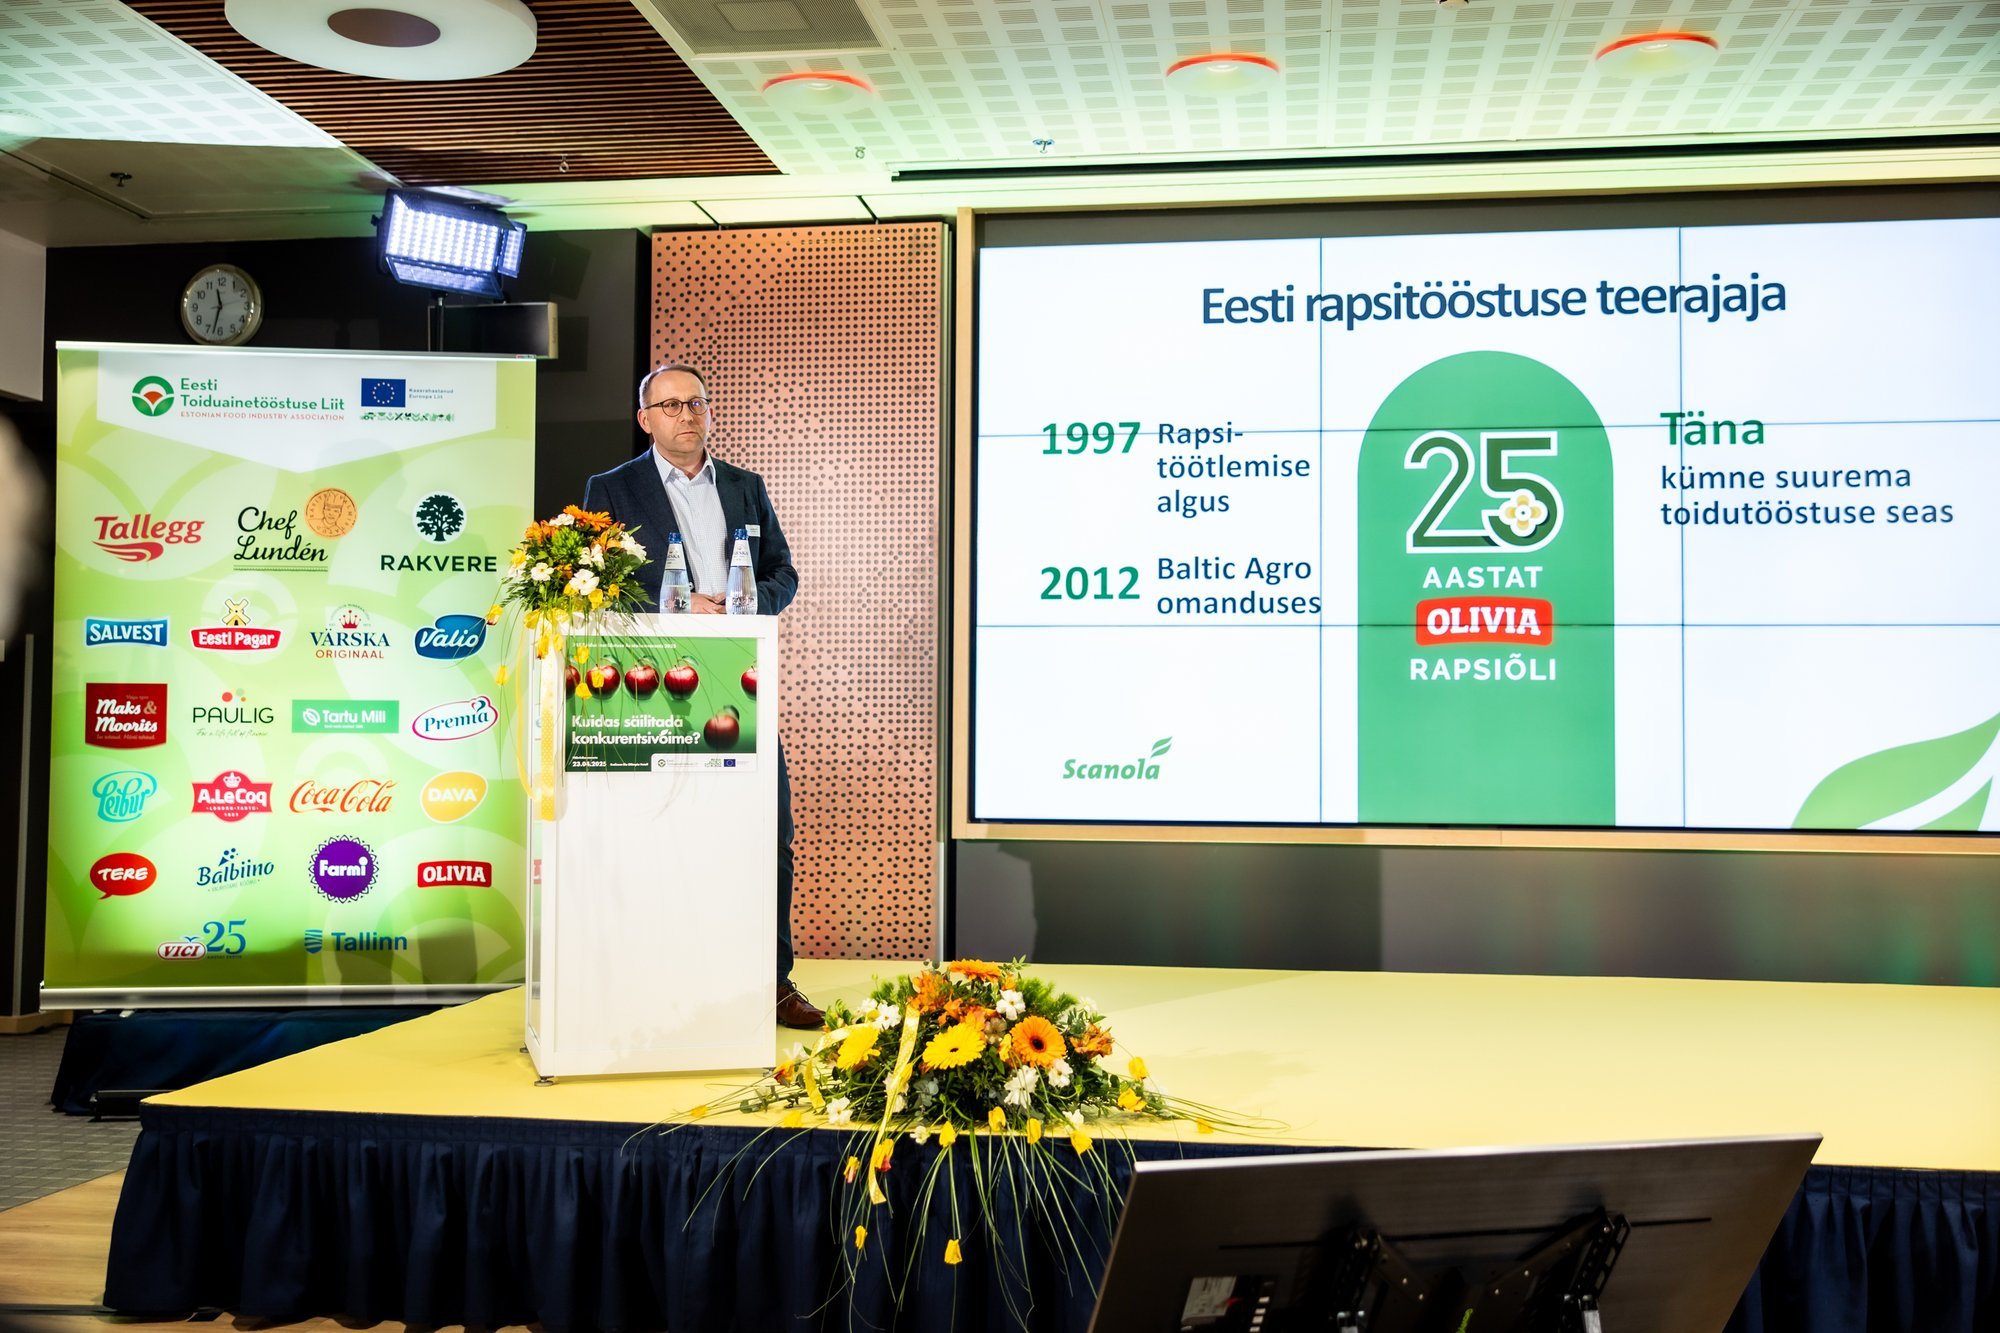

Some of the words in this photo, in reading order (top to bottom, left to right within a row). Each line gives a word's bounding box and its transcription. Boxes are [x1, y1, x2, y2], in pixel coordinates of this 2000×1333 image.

[206, 281, 213, 290] 11
[218, 277, 226, 287] 12
[232, 281, 236, 290] 1
[197, 291, 205, 299] 10
[240, 289, 246, 298] 2
[1202, 284, 1294, 324] Eesti
[1306, 280, 1587, 331] rapsitööstuse
[1596, 272, 1786, 322] teerajaja
[192, 303, 198, 312] 9
[244, 302, 250, 311] 3
[196, 315, 202, 325] 8
[205, 324, 211, 333] 7
[230, 324, 236, 333] 5
[238, 315, 245, 323] 4
[217, 327, 223, 336] 6
[180, 378, 217, 391] Eesti
[180, 394, 318, 410] Toiduainetööstuse
[322, 398, 344, 410] Liit
[249, 412, 287, 420] INDUSTRY
[291, 413, 344, 421] ASSOCIATION
[1042, 421, 1141, 455] 1997
[1158, 421, 1244, 450] Rapsi-
[1660, 411, 1765, 446] Täna
[1157, 454, 1310, 479] töötlemise
[1661, 465, 1765, 490] kümne
[1775, 468, 1911, 489] suurema
[1404, 430, 1565, 554] 25
[1157, 489, 1230, 519] algus
[1660, 500, 1876, 526] toidutööstuse
[1886, 503, 1955, 524] seas
[93, 514, 205, 544] Tallegg
[238, 506, 297, 540] Chef
[233, 534, 328, 562] Lundén
[380, 555, 497, 572] RAKVERE
[1040, 566, 1141, 600] 2012
[1158, 556, 1236, 580] Baltic
[1244, 557, 1312, 585] Agro
[1422, 566, 1543, 589] AASTAT
[1157, 590, 1321, 615] omanduses
[1427, 606, 1541, 636] OLIVIA
[90, 623, 164, 643] SALVEST
[199, 630, 232, 646] Eesti
[235, 631, 275, 649] Pagar
[310, 628, 390, 647] VÄRSKA
[419, 629, 480, 648] Valio
[315, 649, 384, 659] ORIGINAAL
[1410, 653, 1556, 681] RAPSIÕLI
[96, 699, 141, 715] Maks
[143, 700, 157, 715] &
[193, 707, 274, 724] PAULIG
[322, 710, 358, 723] Tartu
[361, 710, 386, 723] Mill
[94, 716, 158, 732] Moorits
[425, 710, 489, 732] Premia
[572, 714, 620, 728] Kuidas
[624, 714, 684, 728] säilitada
[571, 729, 701, 745] konkurentsivõime?
[1062, 758, 1160, 780] Scanola
[92, 770, 157, 823] Leibur
[428, 788, 476, 802] DAVA
[97, 867, 149, 881] TERE
[196, 859, 275, 886] Balbiino
[319, 856, 368, 877] Farmi
[422, 865, 486, 883] OLIVIA
[203, 918, 247, 955] 25
[331, 932, 408, 951] Tallinn
